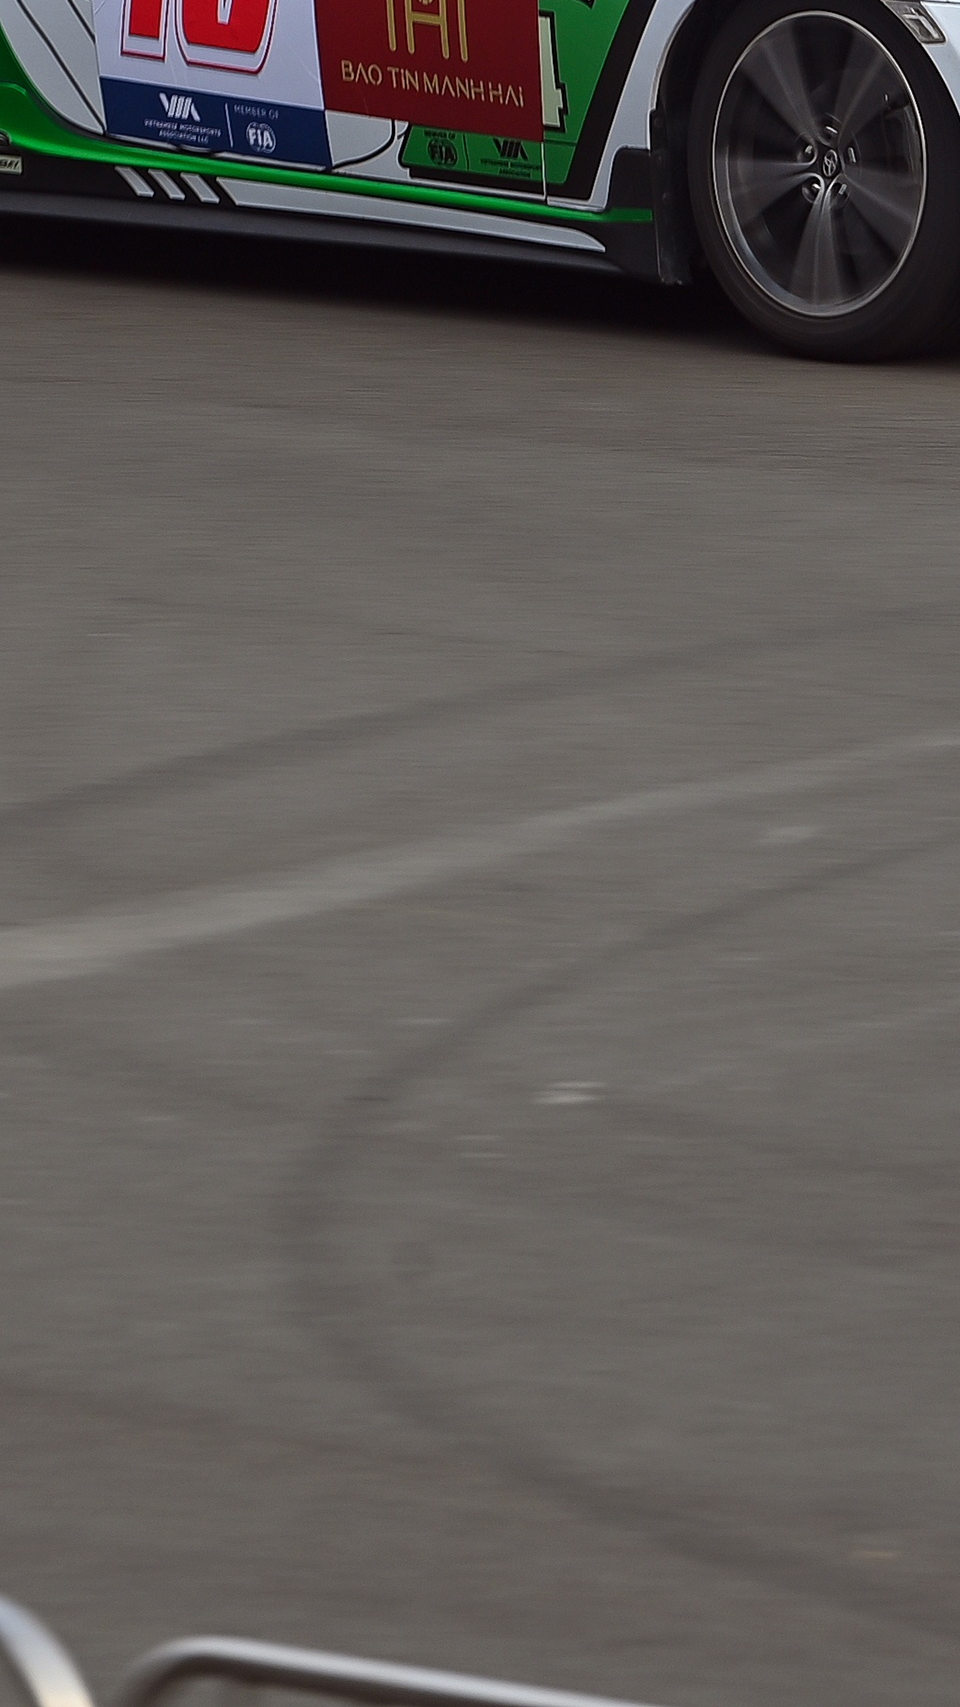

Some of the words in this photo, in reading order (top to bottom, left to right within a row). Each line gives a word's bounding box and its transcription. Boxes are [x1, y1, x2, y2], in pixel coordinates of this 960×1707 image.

[387, 66, 419, 92] TIN
[423, 72, 485, 102] MANH
[489, 81, 524, 108] HAI
[248, 128, 275, 149] FIA
